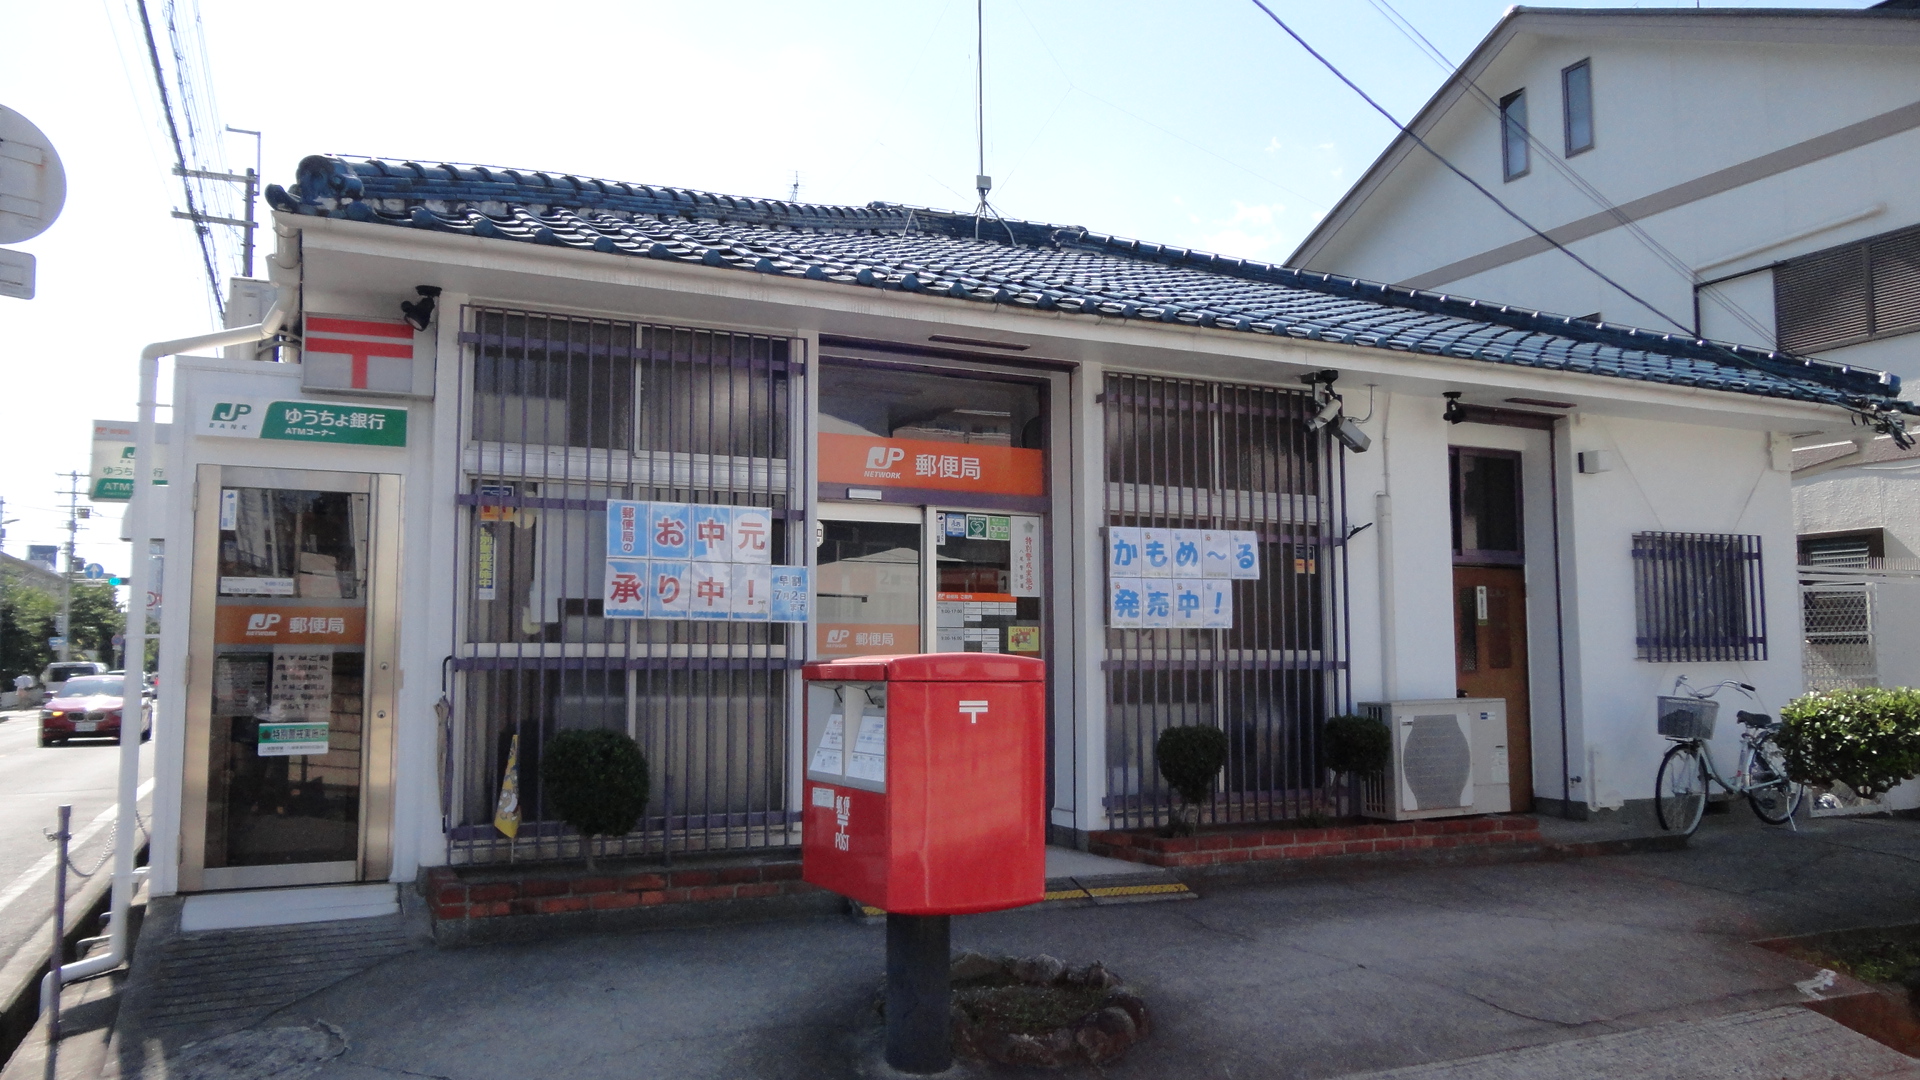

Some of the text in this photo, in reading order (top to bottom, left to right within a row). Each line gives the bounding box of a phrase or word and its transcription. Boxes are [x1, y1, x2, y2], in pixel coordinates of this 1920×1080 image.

[211, 402, 252, 422] JP
[285, 408, 386, 430] ゆうちょ銀行
[209, 423, 248, 431] BANK
[285, 428, 336, 436] ATMコーナー
[866, 446, 981, 480] JP 郵便局
[103, 466, 164, 478] ゆうち行
[863, 470, 901, 479] NETWORK
[103, 482, 134, 491] ATM
[622, 507, 635, 552] 郵便局の
[656, 517, 766, 550] お中元
[779, 575, 802, 587] 早割
[774, 590, 807, 601] 7月2日
[790, 603, 806, 611] まで
[248, 613, 345, 634] JP 郵便局
[855, 633, 894, 646] 郵便局
[836, 795, 850, 816] 郵便
[835, 832, 850, 851] POST
